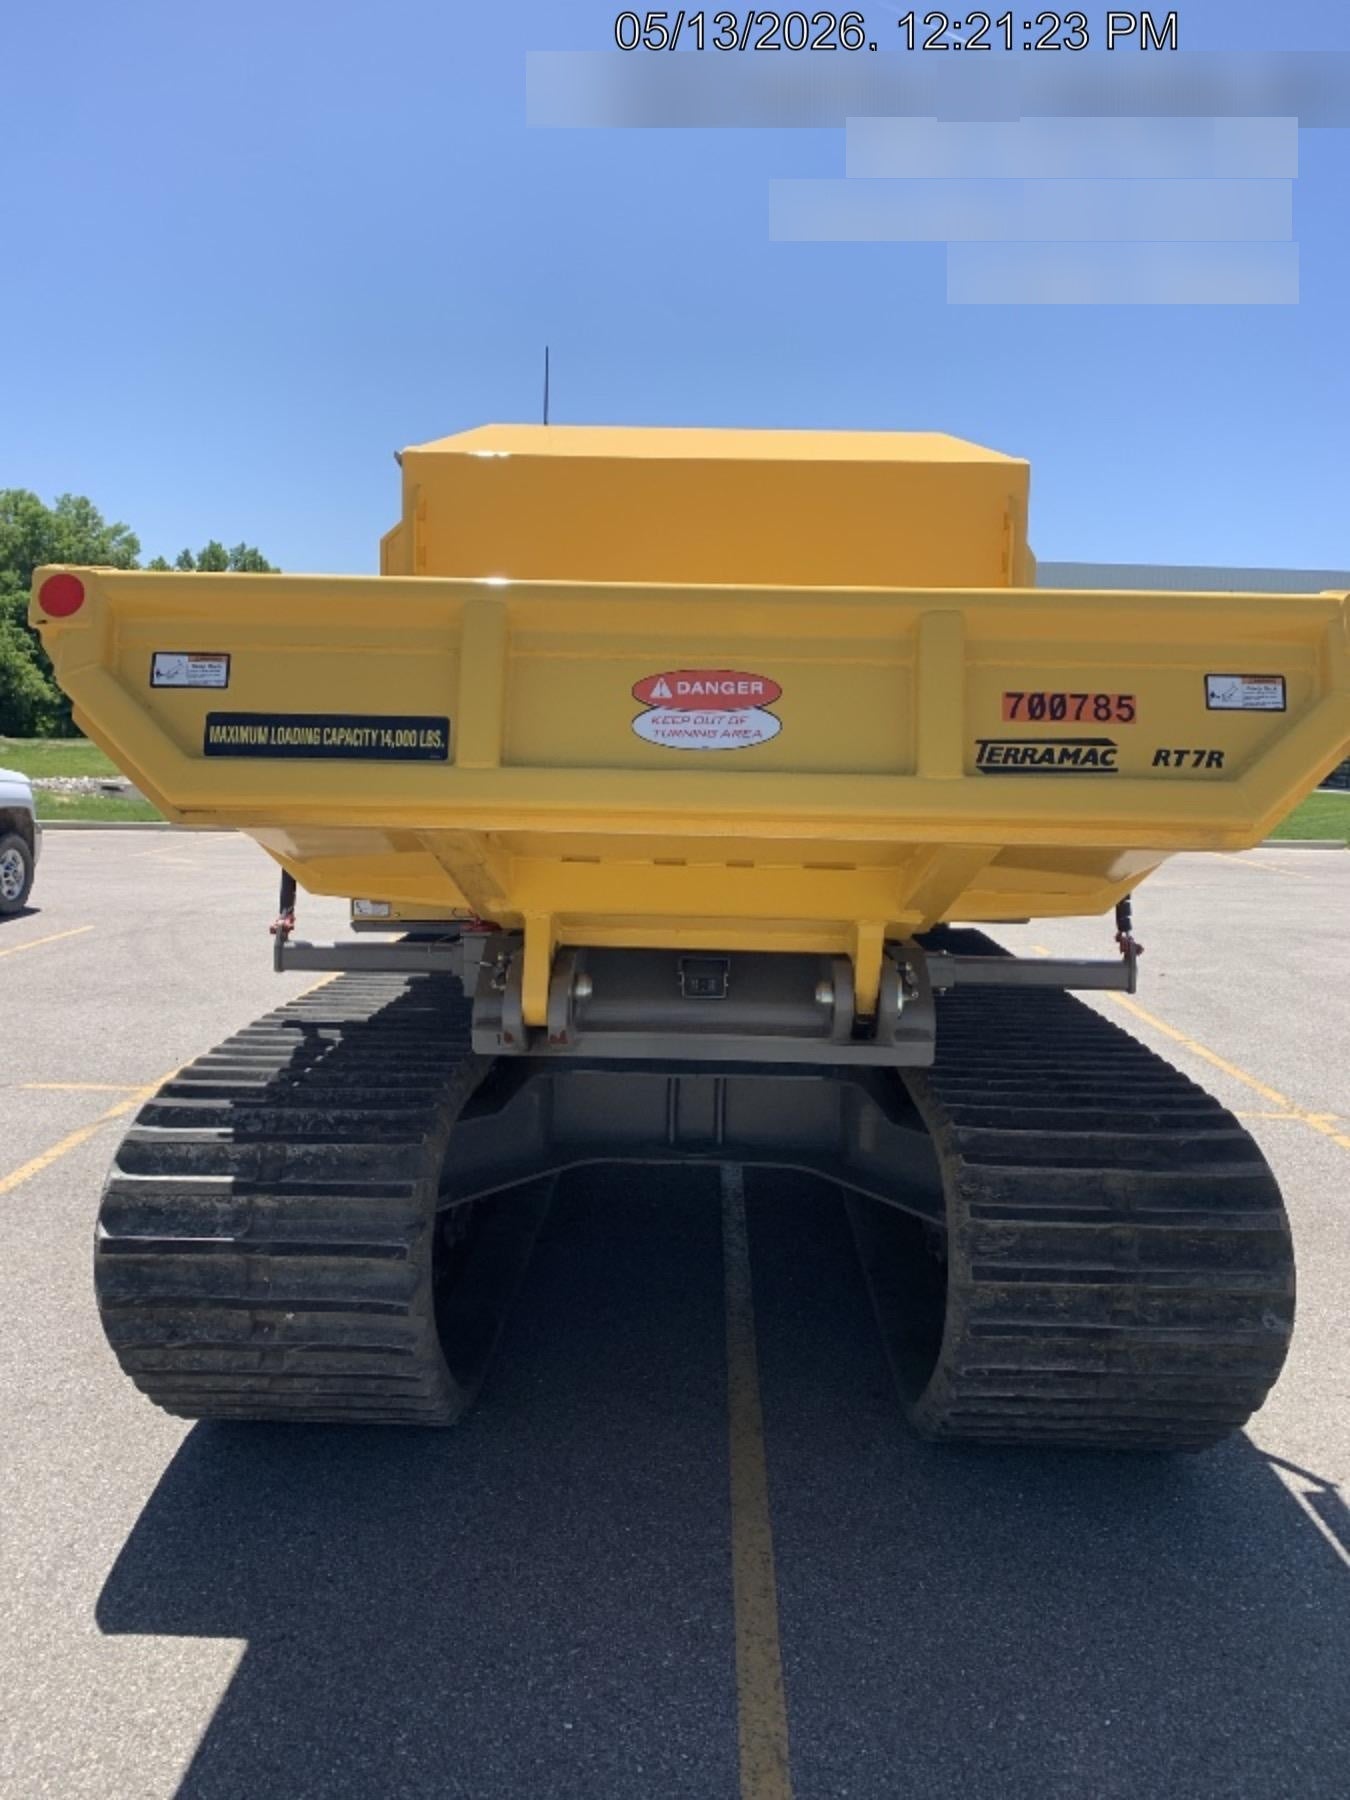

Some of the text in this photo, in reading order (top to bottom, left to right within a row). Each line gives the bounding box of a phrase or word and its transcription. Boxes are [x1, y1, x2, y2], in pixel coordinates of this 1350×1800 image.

[677, 681, 764, 695] DANGER
[1005, 692, 1136, 723] 700785
[651, 715, 750, 725] KEEP OUT OF
[209, 725, 445, 748] MAXIMUM LOADING CAPACITY 14,000 LBS.
[653, 729, 763, 739] TURNING AREA
[976, 738, 1118, 769] TERRAMAC
[1152, 749, 1225, 769] RT7R
